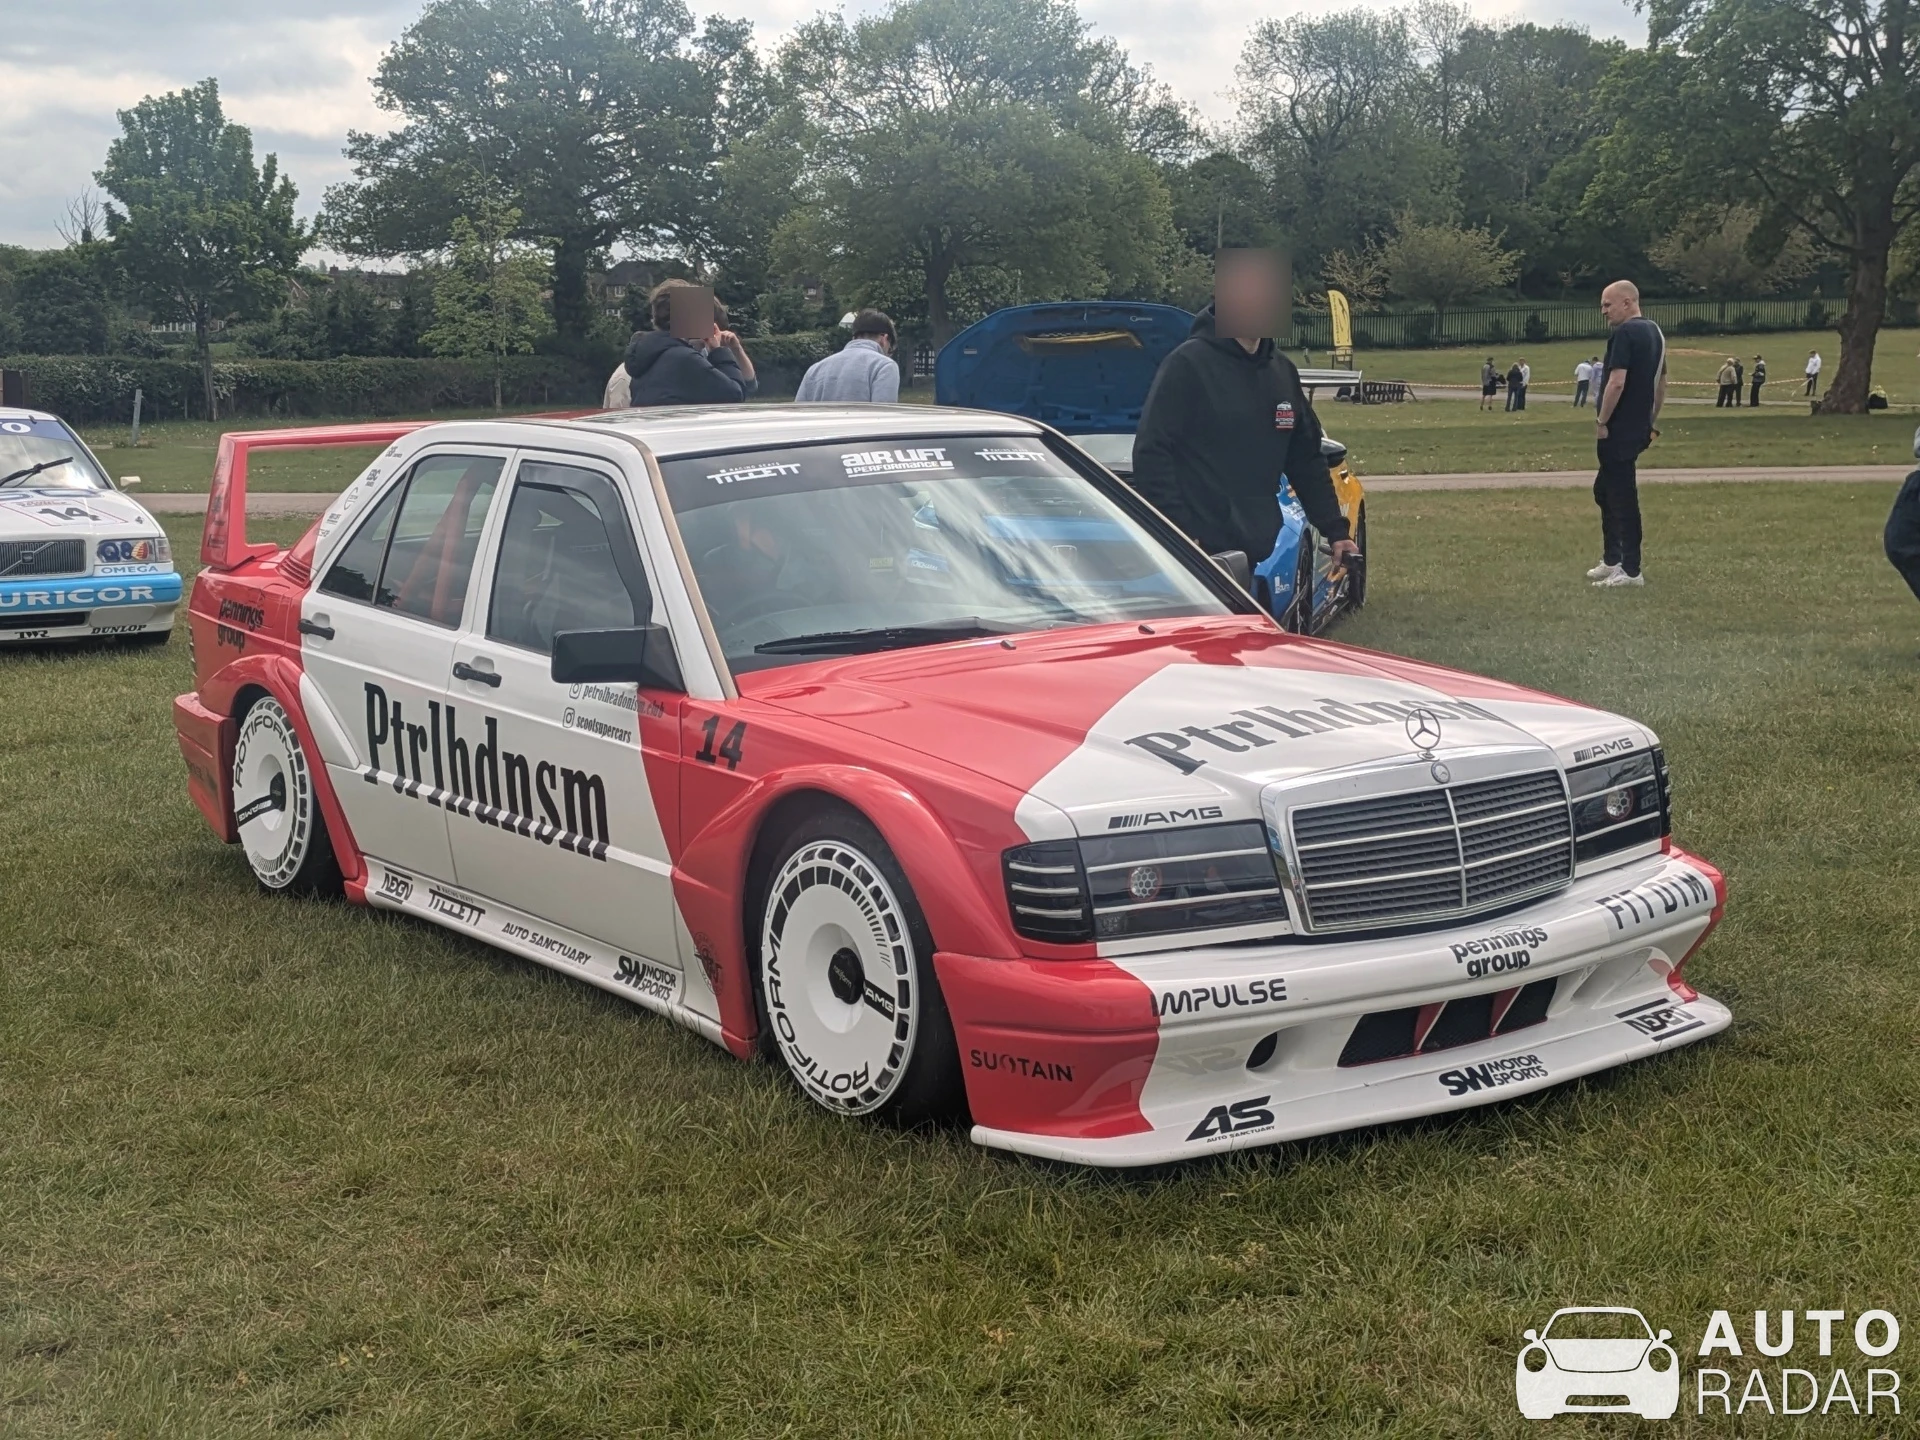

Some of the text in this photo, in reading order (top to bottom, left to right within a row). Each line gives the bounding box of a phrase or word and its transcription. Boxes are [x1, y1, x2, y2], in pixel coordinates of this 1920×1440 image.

[895, 448, 946, 463] LIFT
[974, 452, 1046, 461] TILLETT
[707, 464, 801, 484] TILLETT
[36, 507, 100, 521] 14
[101, 566, 158, 574] OMEGA
[219, 598, 264, 632] pennings
[14, 630, 49, 639] TWR
[91, 624, 147, 635] DUNLOP
[217, 624, 245, 654] group
[576, 714, 632, 744] scootsupercars
[695, 714, 747, 771] 14
[235, 714, 292, 788] ROTIFORM
[1591, 737, 1634, 758] AMG
[364, 682, 609, 862] Ptrlhdnsm
[1143, 806, 1223, 826] AMG
[428, 888, 486, 926] TILLETT
[502, 922, 592, 966] AUTO SANCTUARY
[1449, 926, 1548, 963] pennings
[613, 955, 646, 988] SW
[646, 965, 676, 988] MOTOR
[1466, 949, 1531, 979] group
[638, 978, 672, 1000] SPORTS
[865, 987, 894, 1013] AMG
[1151, 978, 1287, 1017] IMPULSE
[767, 939, 870, 1094] ROTIFORM
[1489, 1053, 1545, 1073] MOTOR
[1493, 1065, 1549, 1086] SPORTS
[1439, 1062, 1497, 1096] SW
[1185, 1095, 1275, 1142] AS
[1206, 1125, 1275, 1143] AUTO SANCTUARY
